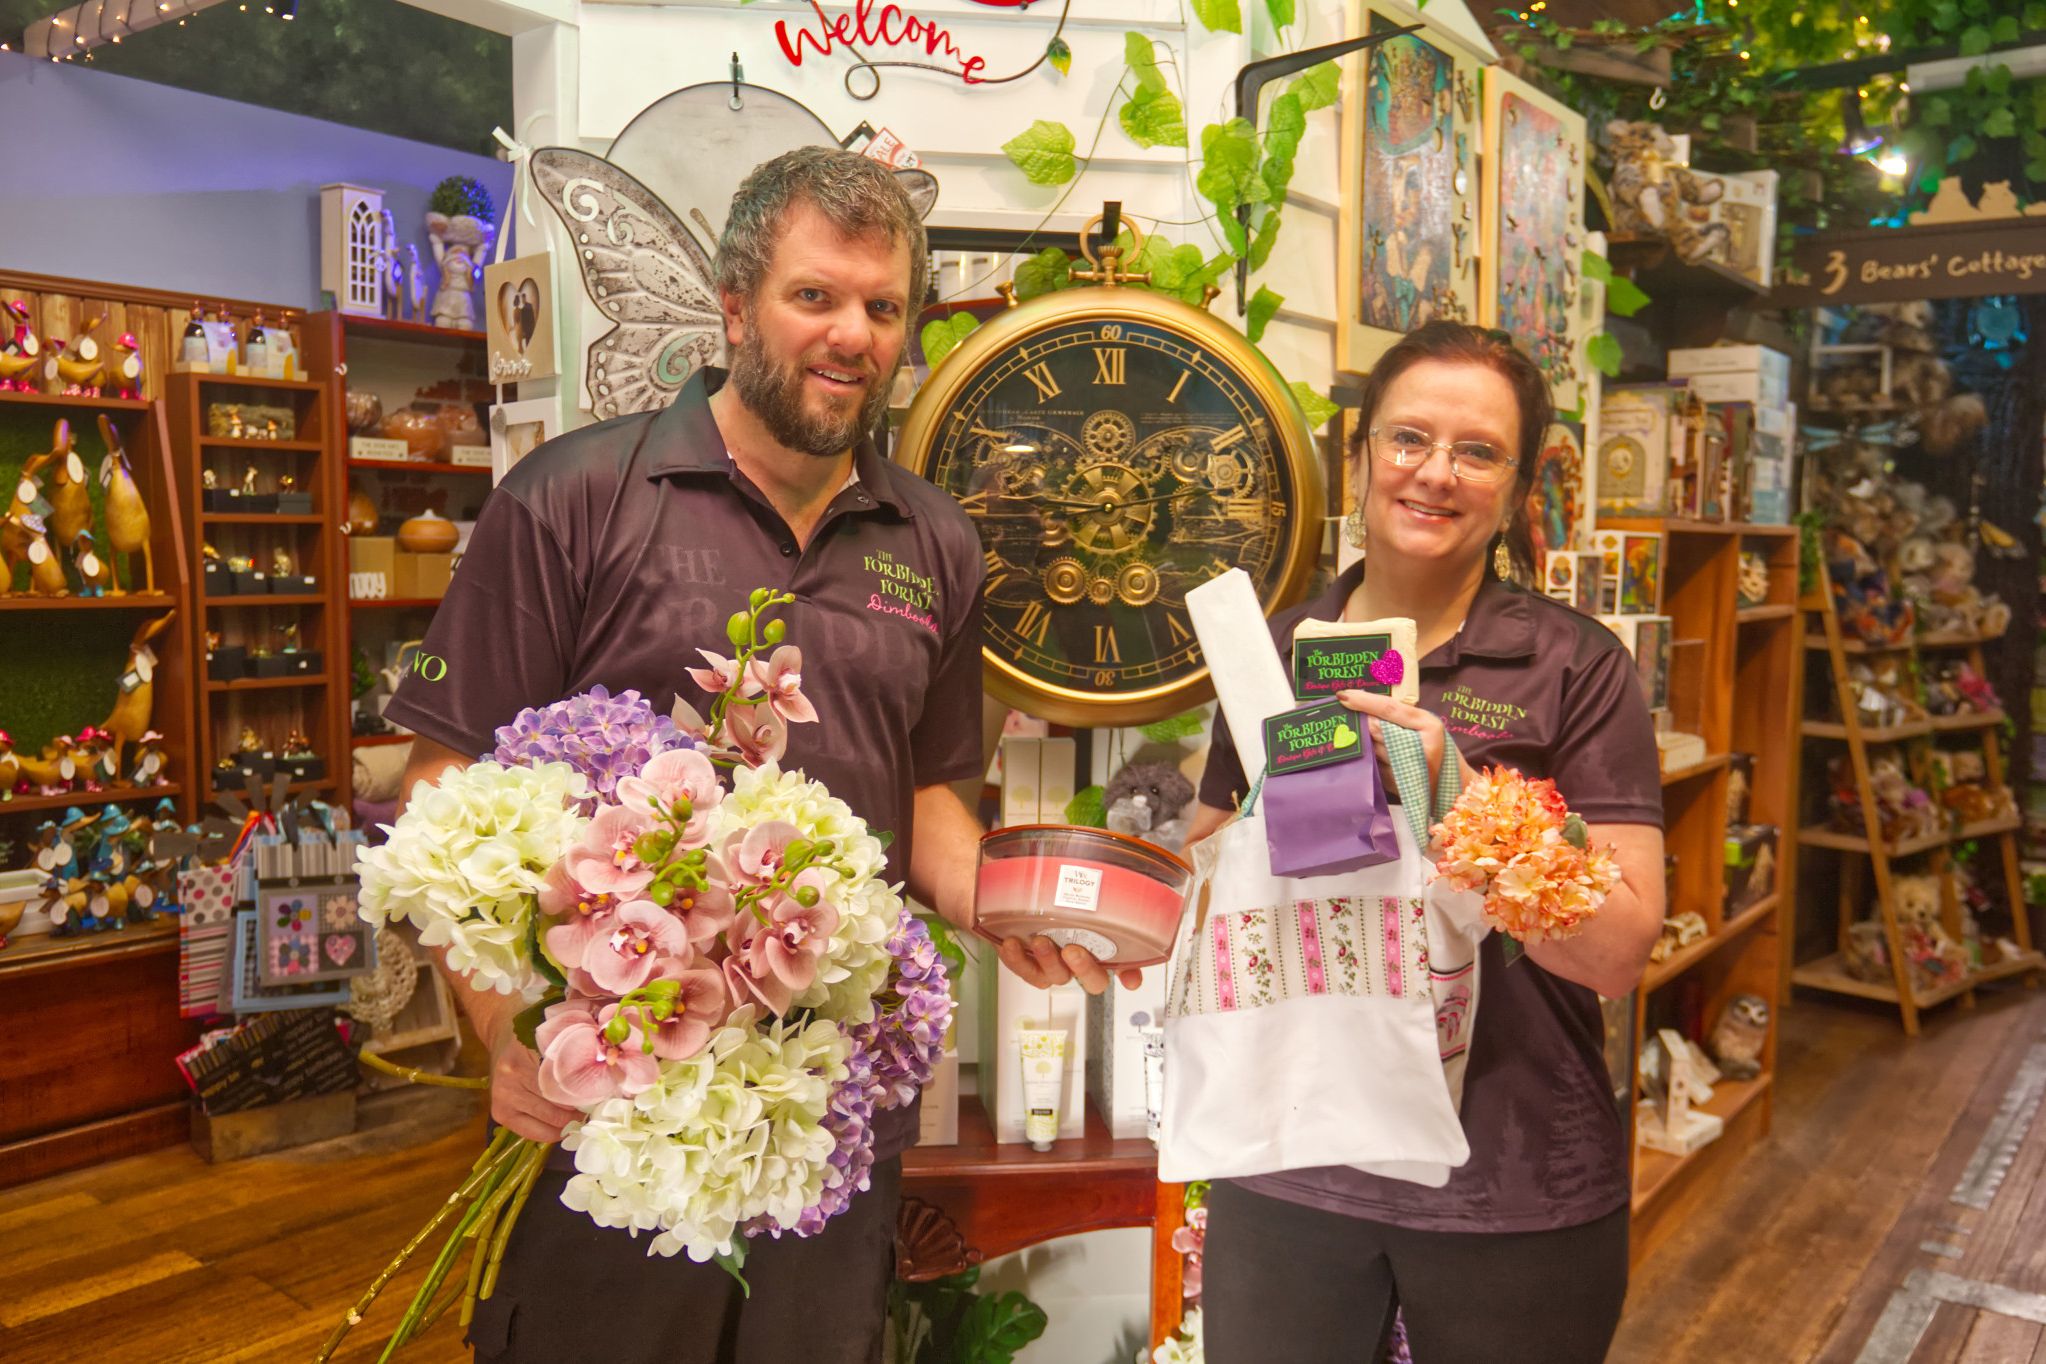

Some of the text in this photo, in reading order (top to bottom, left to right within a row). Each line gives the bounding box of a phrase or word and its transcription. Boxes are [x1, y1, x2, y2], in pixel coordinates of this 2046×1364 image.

[1820, 250, 1848, 295] 3
[1860, 253, 1939, 284] Bears'
[1101, 325, 1122, 342] 60
[1092, 347, 1127, 385] XII
[1022, 360, 1062, 404] XI
[1167, 368, 1192, 403] I
[1210, 422, 1248, 453] II
[1227, 498, 1264, 518] III
[1271, 501, 1287, 517] 15
[880, 579, 933, 610] FOREST
[1013, 601, 1052, 648] VII
[1166, 612, 1191, 646] V
[1093, 625, 1122, 664] VI
[1306, 650, 1379, 668] FORBIDDEN
[1094, 670, 1116, 687] 30
[1318, 664, 1365, 680] FOREST
[1441, 691, 1528, 721] FORBIDDEN
[1450, 706, 1510, 730] FOREST
[1289, 728, 1334, 752] FOREST
[1064, 877, 1096, 887] TRILOGY
